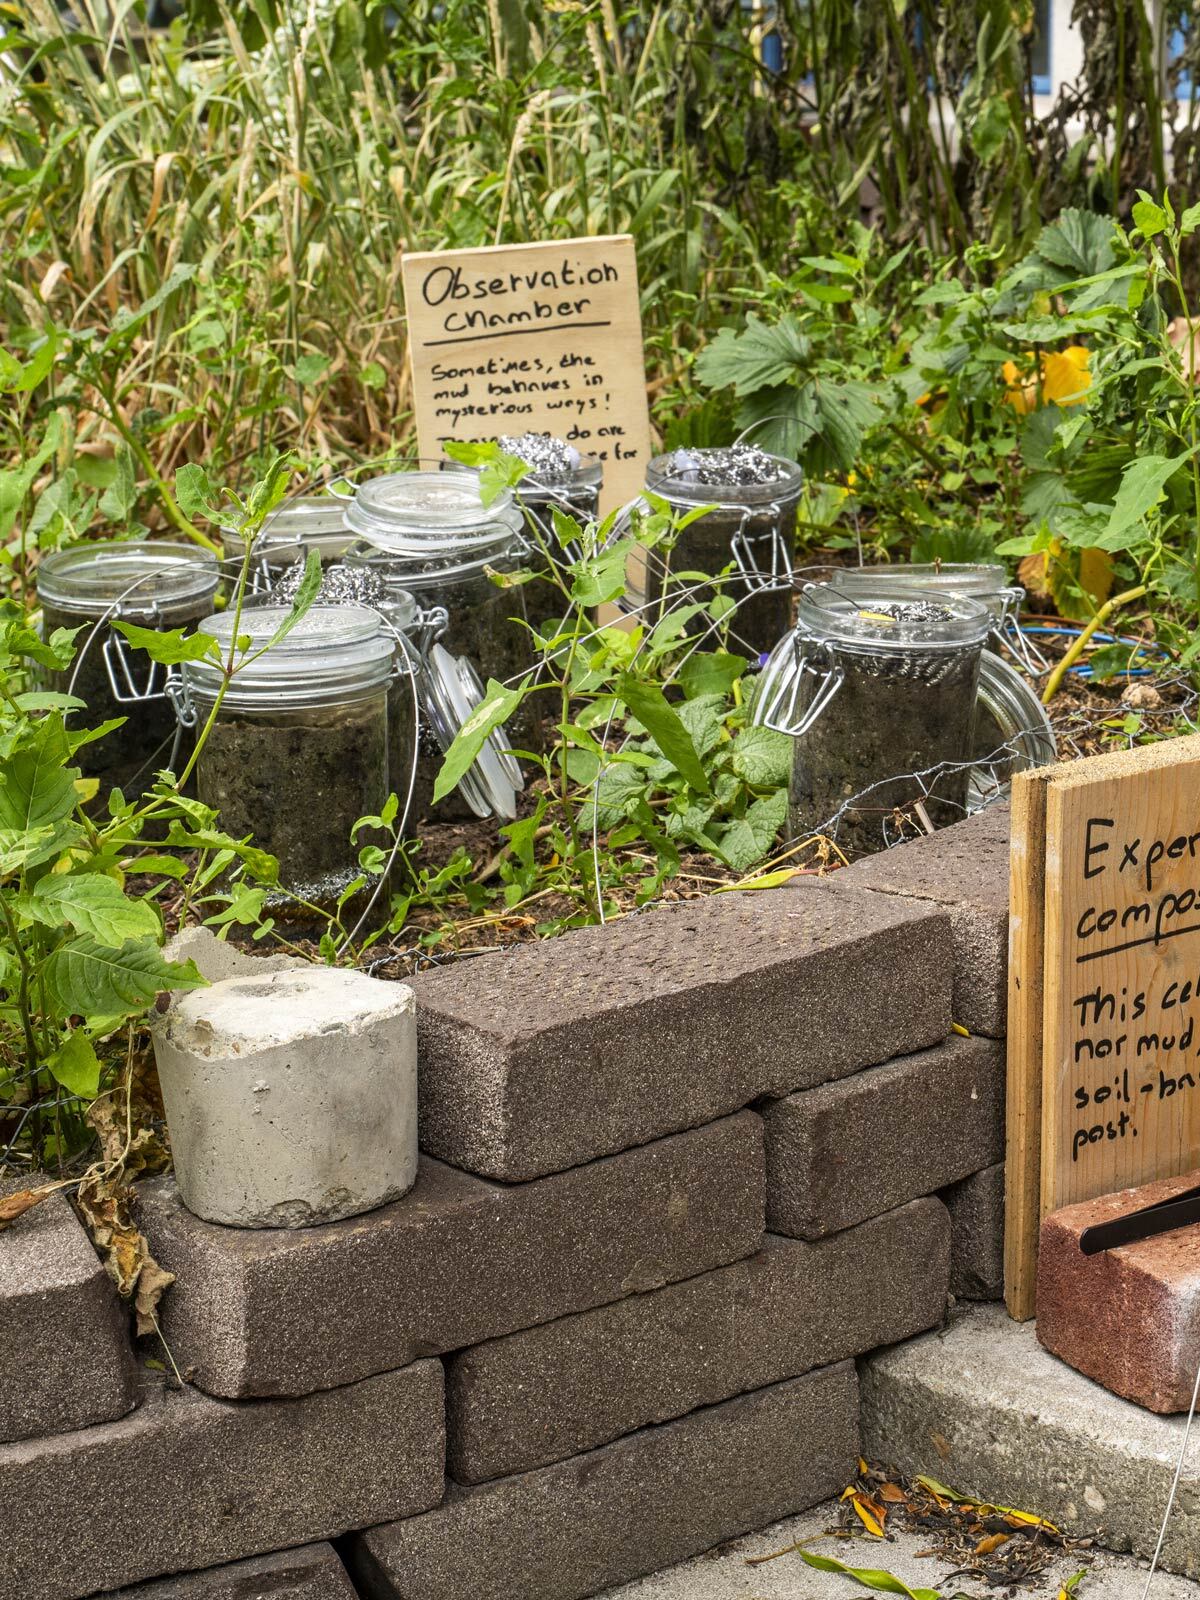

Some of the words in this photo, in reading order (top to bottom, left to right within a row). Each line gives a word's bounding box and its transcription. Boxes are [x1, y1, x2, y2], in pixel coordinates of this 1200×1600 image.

[422, 259, 619, 306] Observation
[431, 357, 553, 381] Sometimes,
[559, 353, 596, 368] the
[433, 383, 469, 400] mud
[487, 379, 571, 396] behaves
[583, 374, 604, 386] in
[435, 402, 533, 428] mysterious
[566, 424, 591, 441] do
[597, 425, 626, 437] are
[614, 442, 638, 460] for
[1073, 986, 1146, 1027] This
[1072, 1111, 1138, 1162] post.
